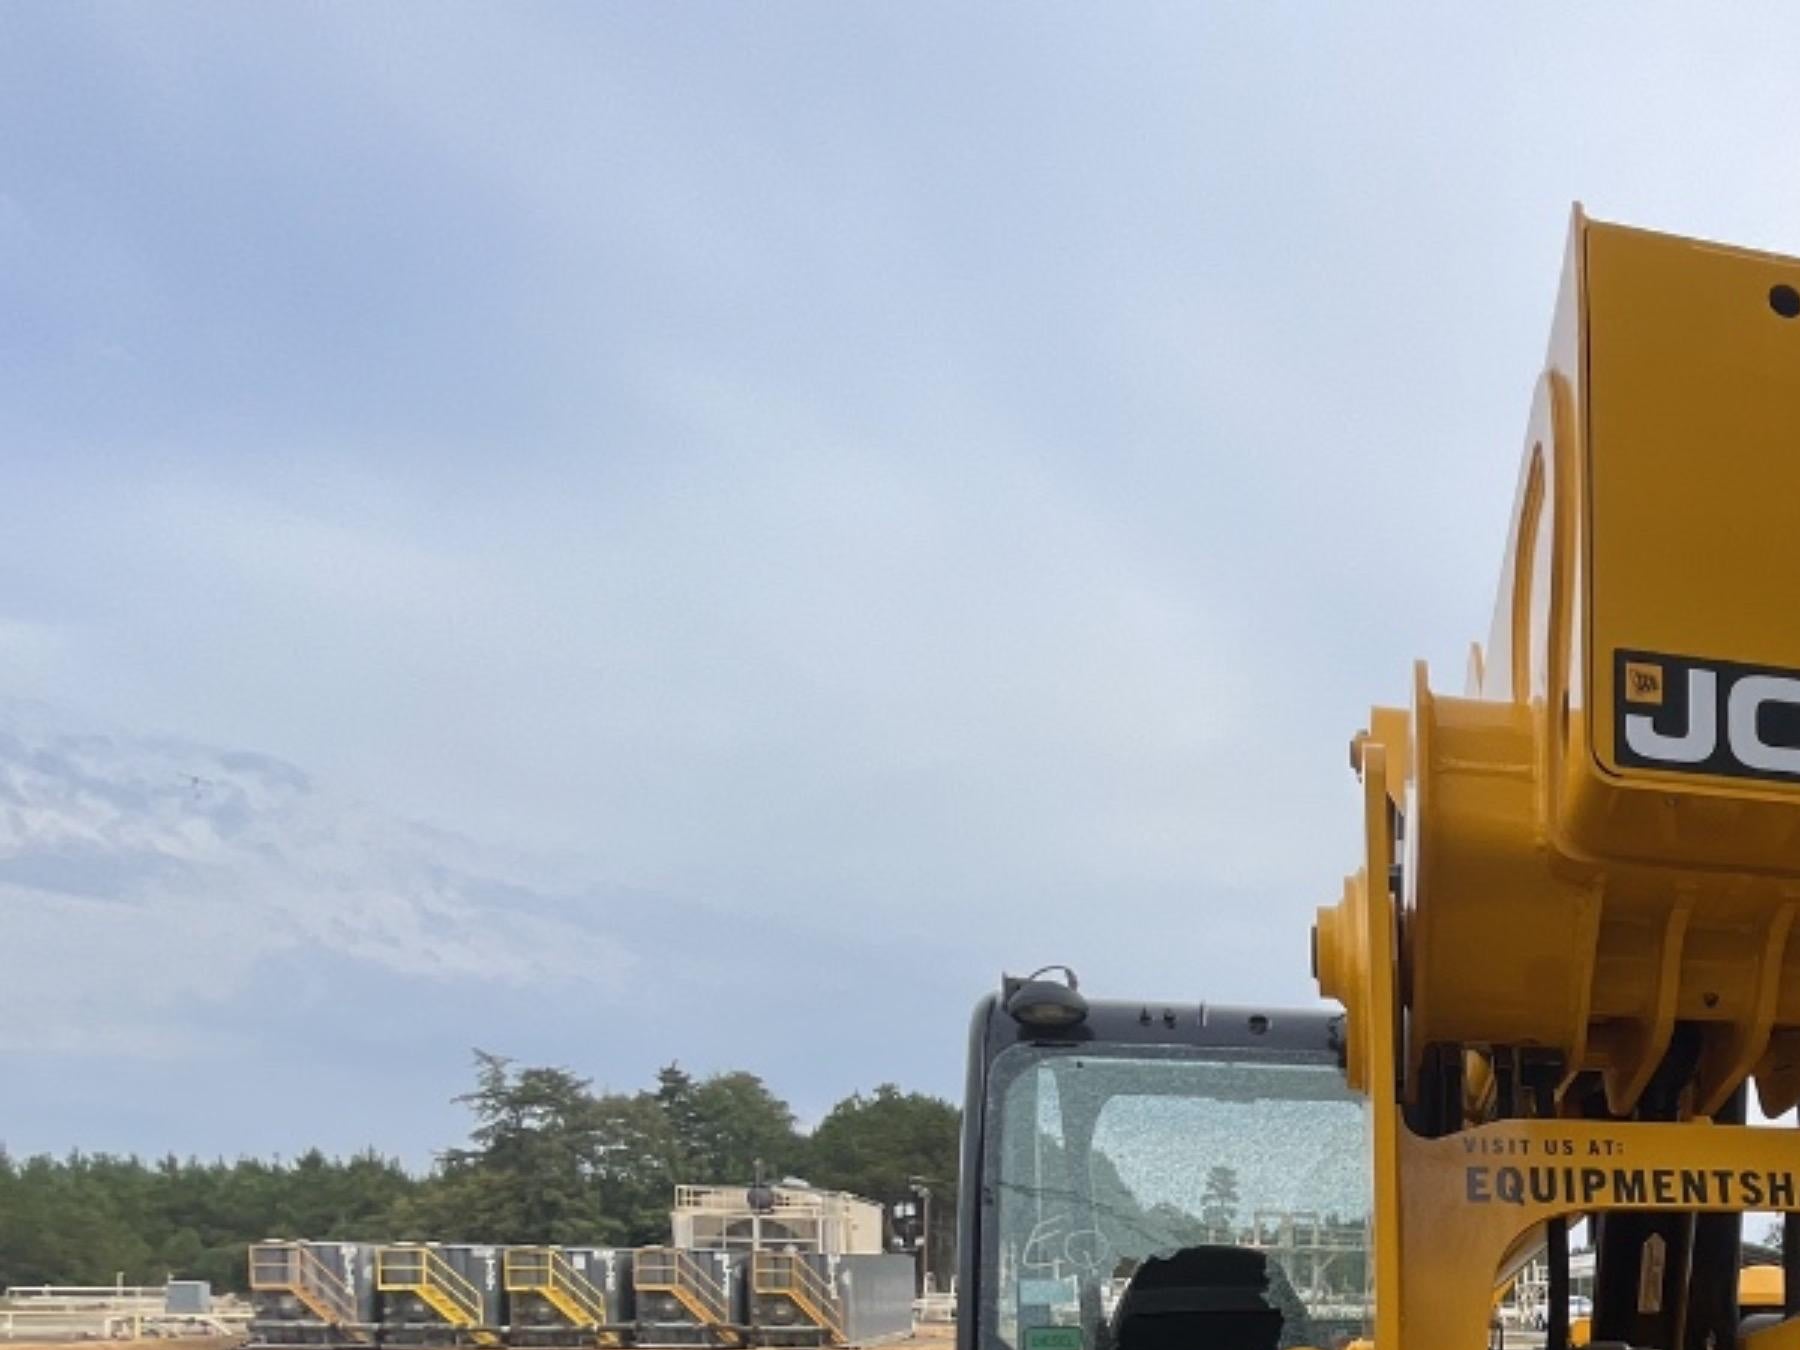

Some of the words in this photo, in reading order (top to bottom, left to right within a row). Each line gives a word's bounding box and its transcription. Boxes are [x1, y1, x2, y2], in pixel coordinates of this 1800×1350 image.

[1464, 1137, 1531, 1155] VISIT
[1544, 1139, 1573, 1156] US
[1588, 1139, 1624, 1156] AT:
